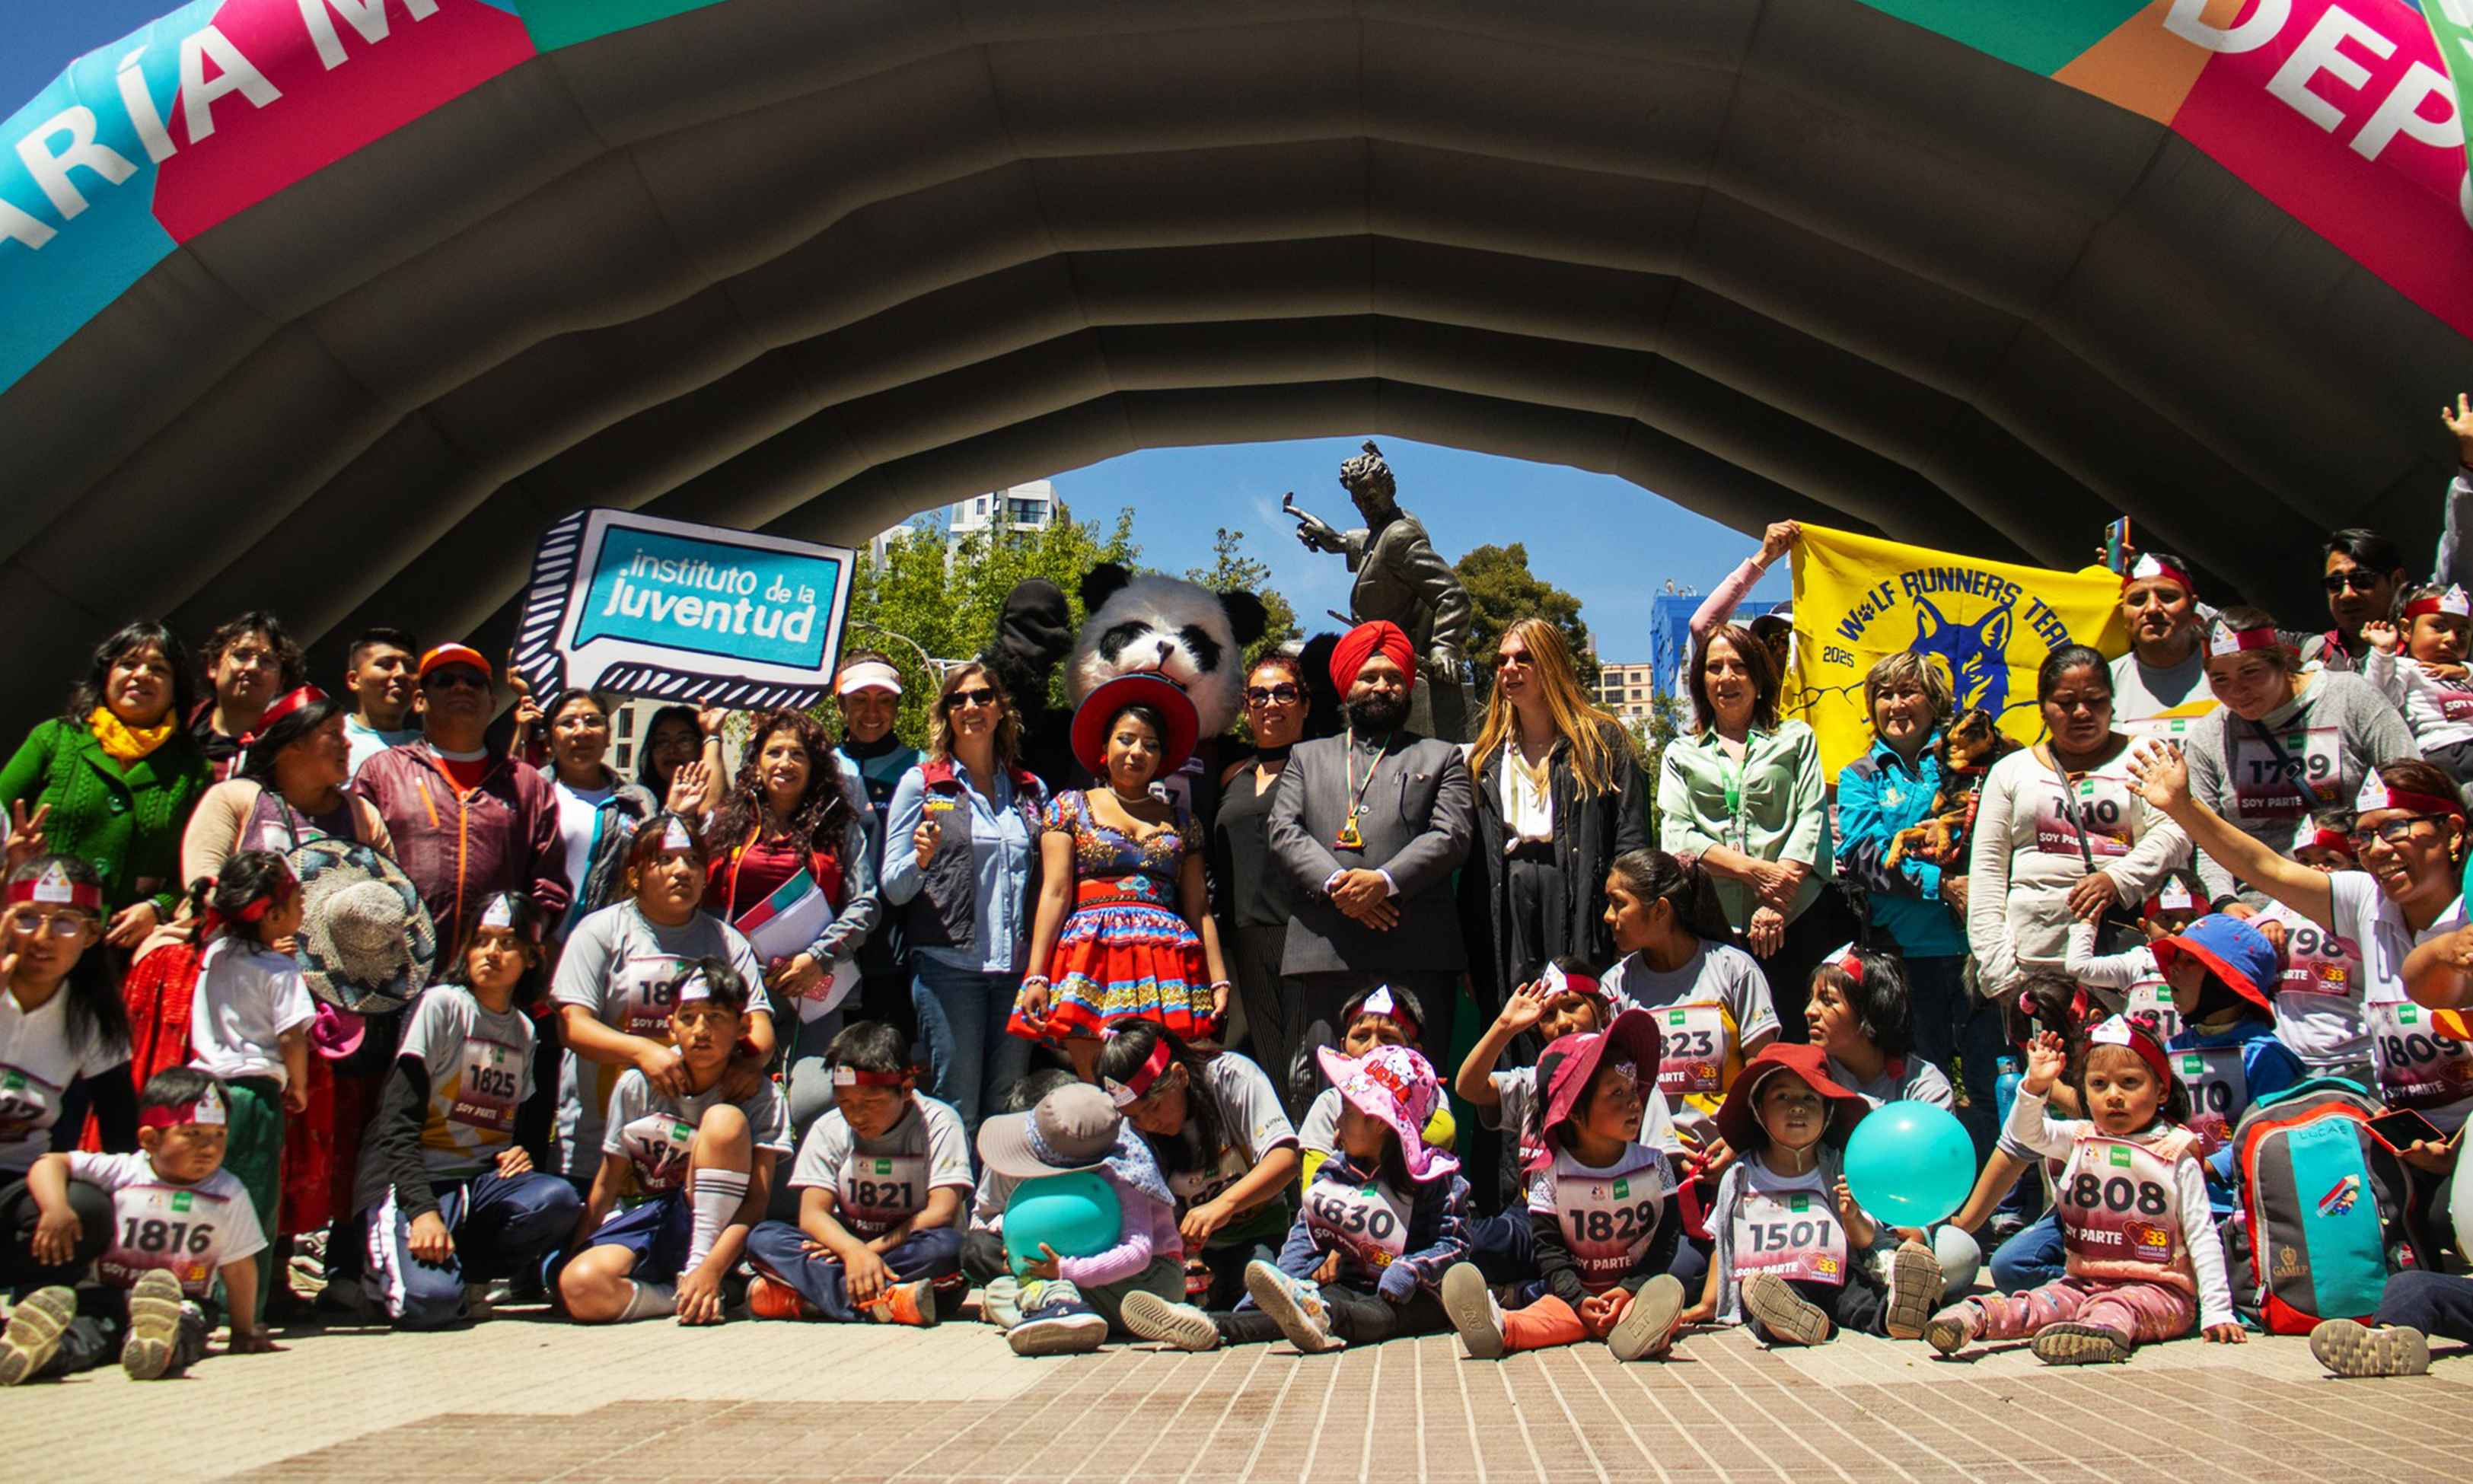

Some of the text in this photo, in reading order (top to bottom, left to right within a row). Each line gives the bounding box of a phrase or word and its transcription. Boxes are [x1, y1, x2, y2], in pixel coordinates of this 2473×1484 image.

[2162, 0, 2473, 230] DEP
[630, 548, 815, 604] instituto de la
[1900, 567, 2022, 608] RUNNERS
[602, 569, 817, 644] juventud
[1822, 646, 1855, 669] 2025
[2248, 753, 2331, 784] 179
[2242, 796, 2303, 807] SOY PARTE
[2039, 833, 2060, 842] SOY
[2284, 928, 2345, 957] 798
[639, 981, 671, 1005] 18
[632, 1017, 654, 1027] SOY
[2379, 1031, 2463, 1068] 1809
[470, 1064, 516, 1099] 1825
[1657, 1072, 1685, 1083] ARTE
[2409, 1081, 2445, 1096] PARTE
[456, 1102, 475, 1114] SOY
[848, 1177, 912, 1209] 1821
[856, 1219, 887, 1231] PARTE
[1312, 1191, 1395, 1240] 1830
[1570, 1200, 1656, 1242] 1829
[123, 1217, 215, 1254] 1816
[1749, 1220, 1831, 1253] 1501
[2080, 1228, 2123, 1246] PARTE
[2147, 1231, 2168, 1246] 33
[1592, 1256, 1632, 1270] PARTE
[1734, 1261, 1799, 1278] SOY PARTE
[1819, 1259, 1837, 1272] 33
[2272, 1265, 2309, 1277] GAMLP
